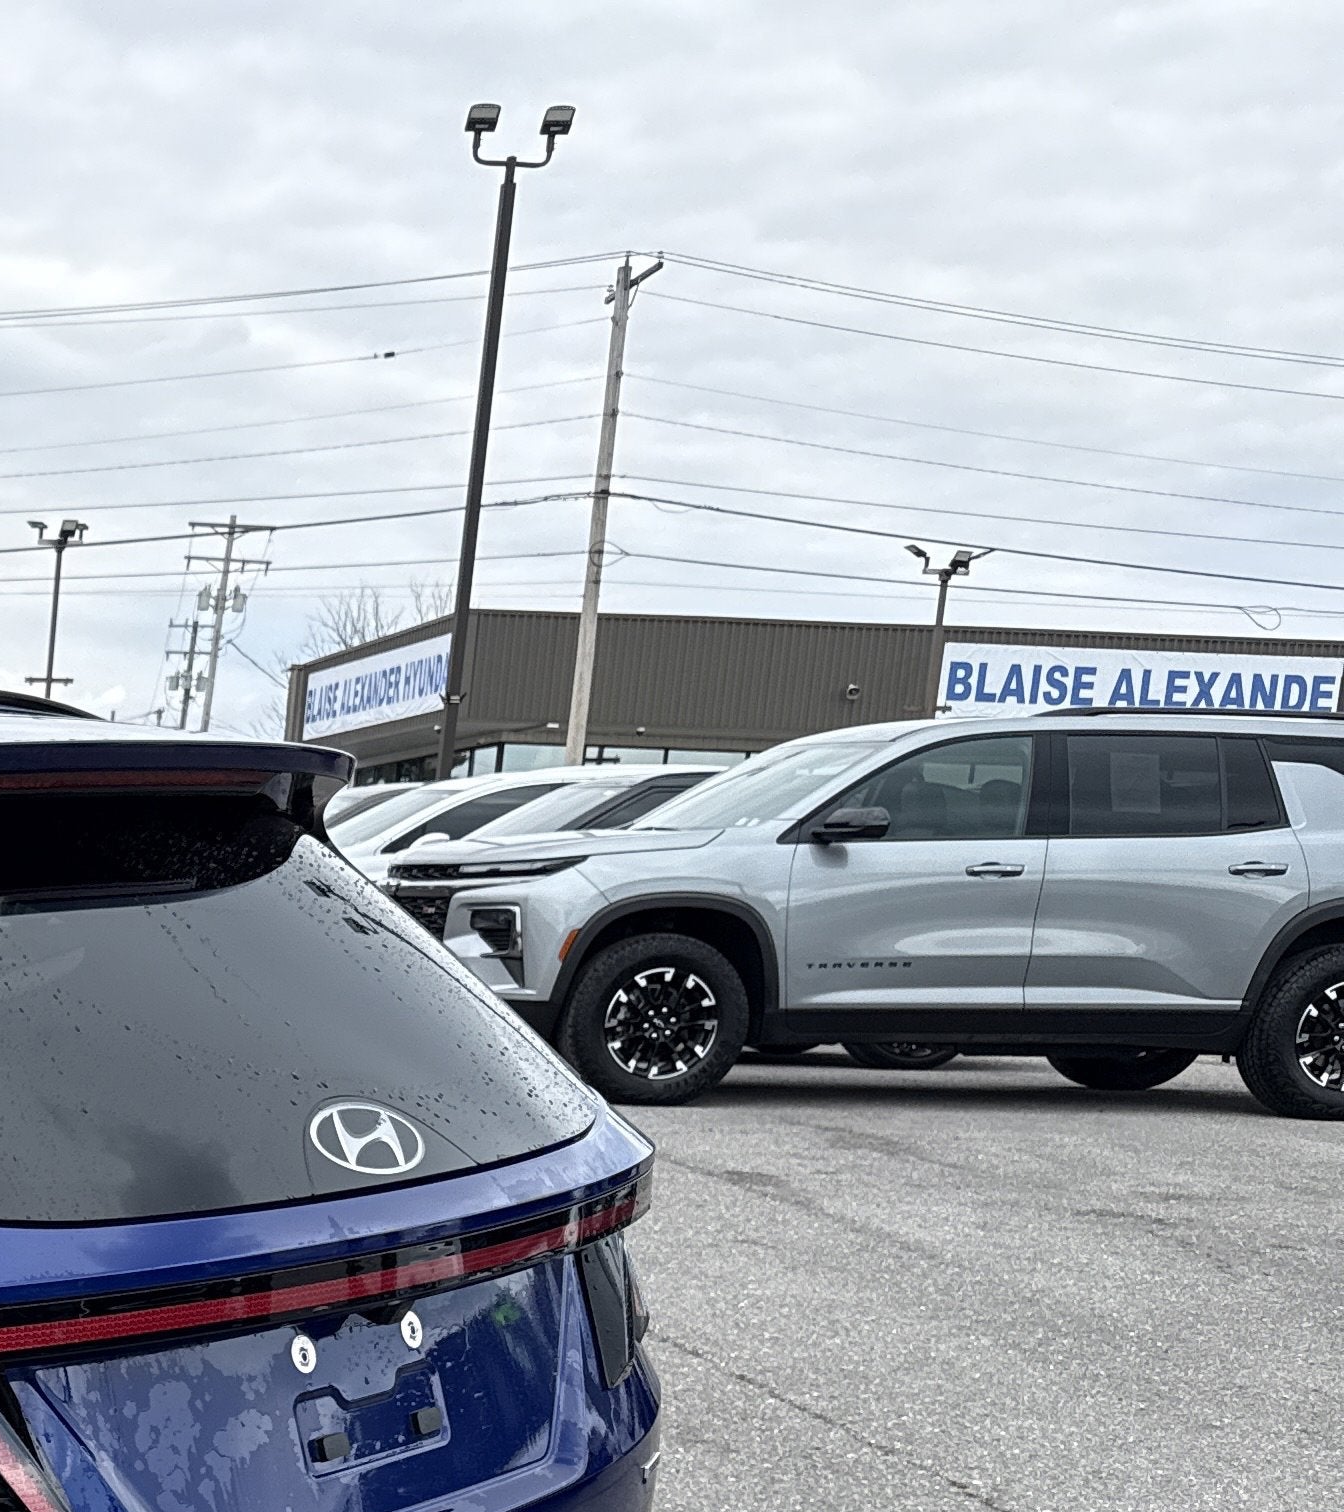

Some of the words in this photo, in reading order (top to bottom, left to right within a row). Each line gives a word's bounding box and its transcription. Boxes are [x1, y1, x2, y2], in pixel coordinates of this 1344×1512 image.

[306, 683, 339, 724] BLAISE
[339, 665, 402, 716] ALEXANDER
[946, 661, 1097, 706] BLAISE
[807, 961, 912, 969] TRAVERSE
